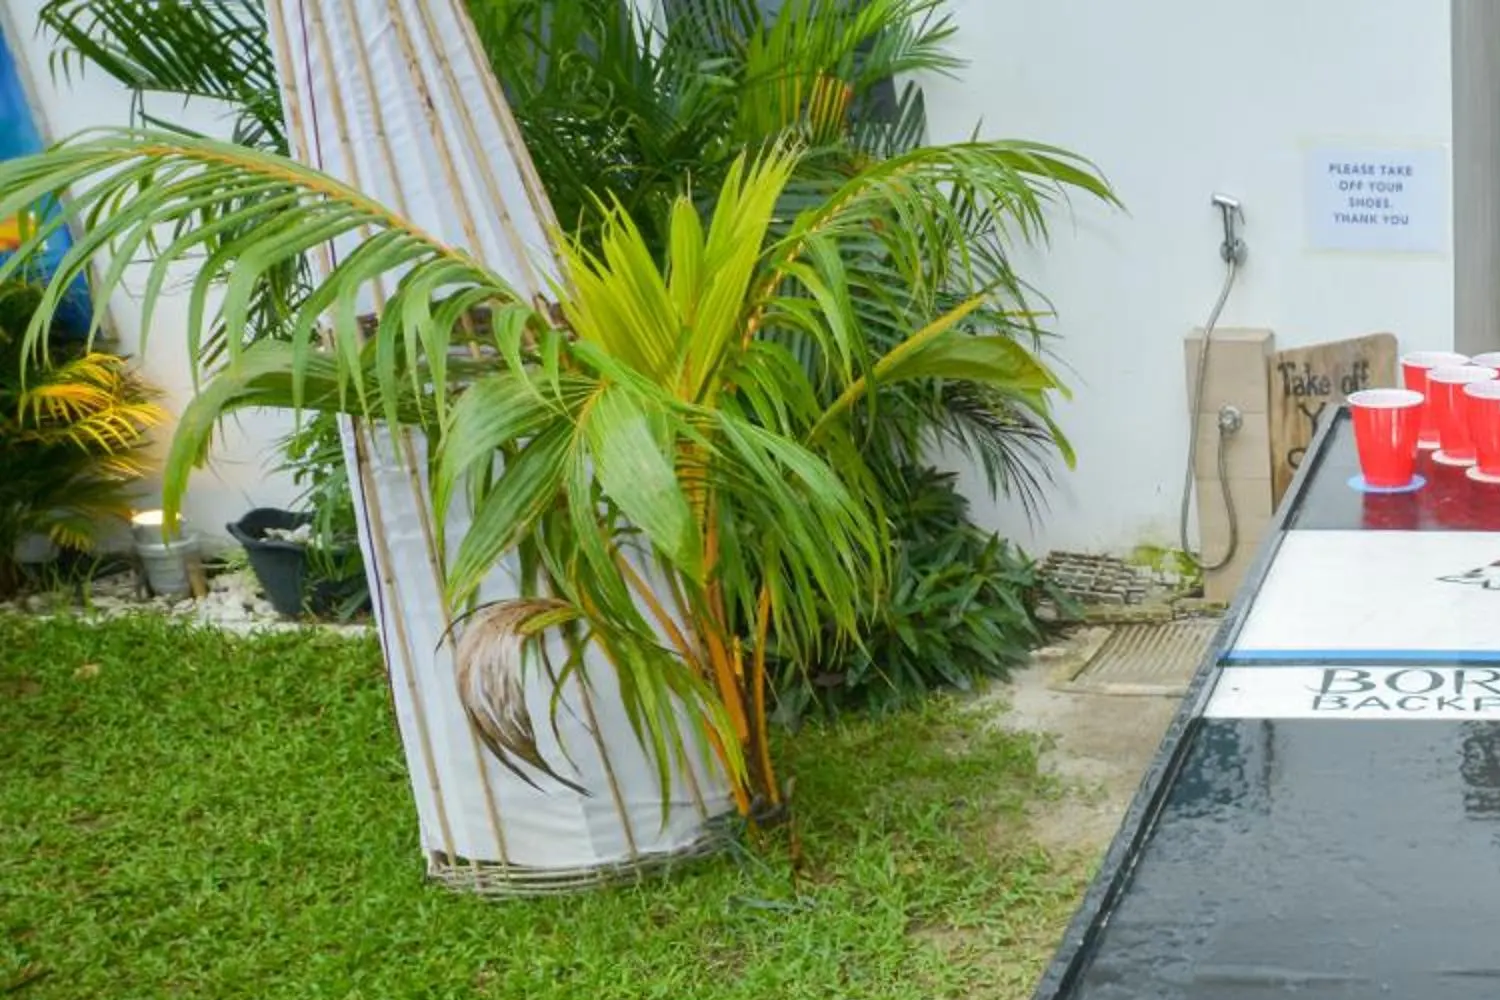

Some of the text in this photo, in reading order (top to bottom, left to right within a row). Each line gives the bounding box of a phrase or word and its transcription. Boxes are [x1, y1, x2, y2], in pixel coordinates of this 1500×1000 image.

[1328, 163, 1413, 177] PLEASE TAKE
[1338, 180, 1403, 193] OFF YOUR
[1333, 212, 1409, 226] THANK YOU
[1277, 360, 1369, 396] Take off
